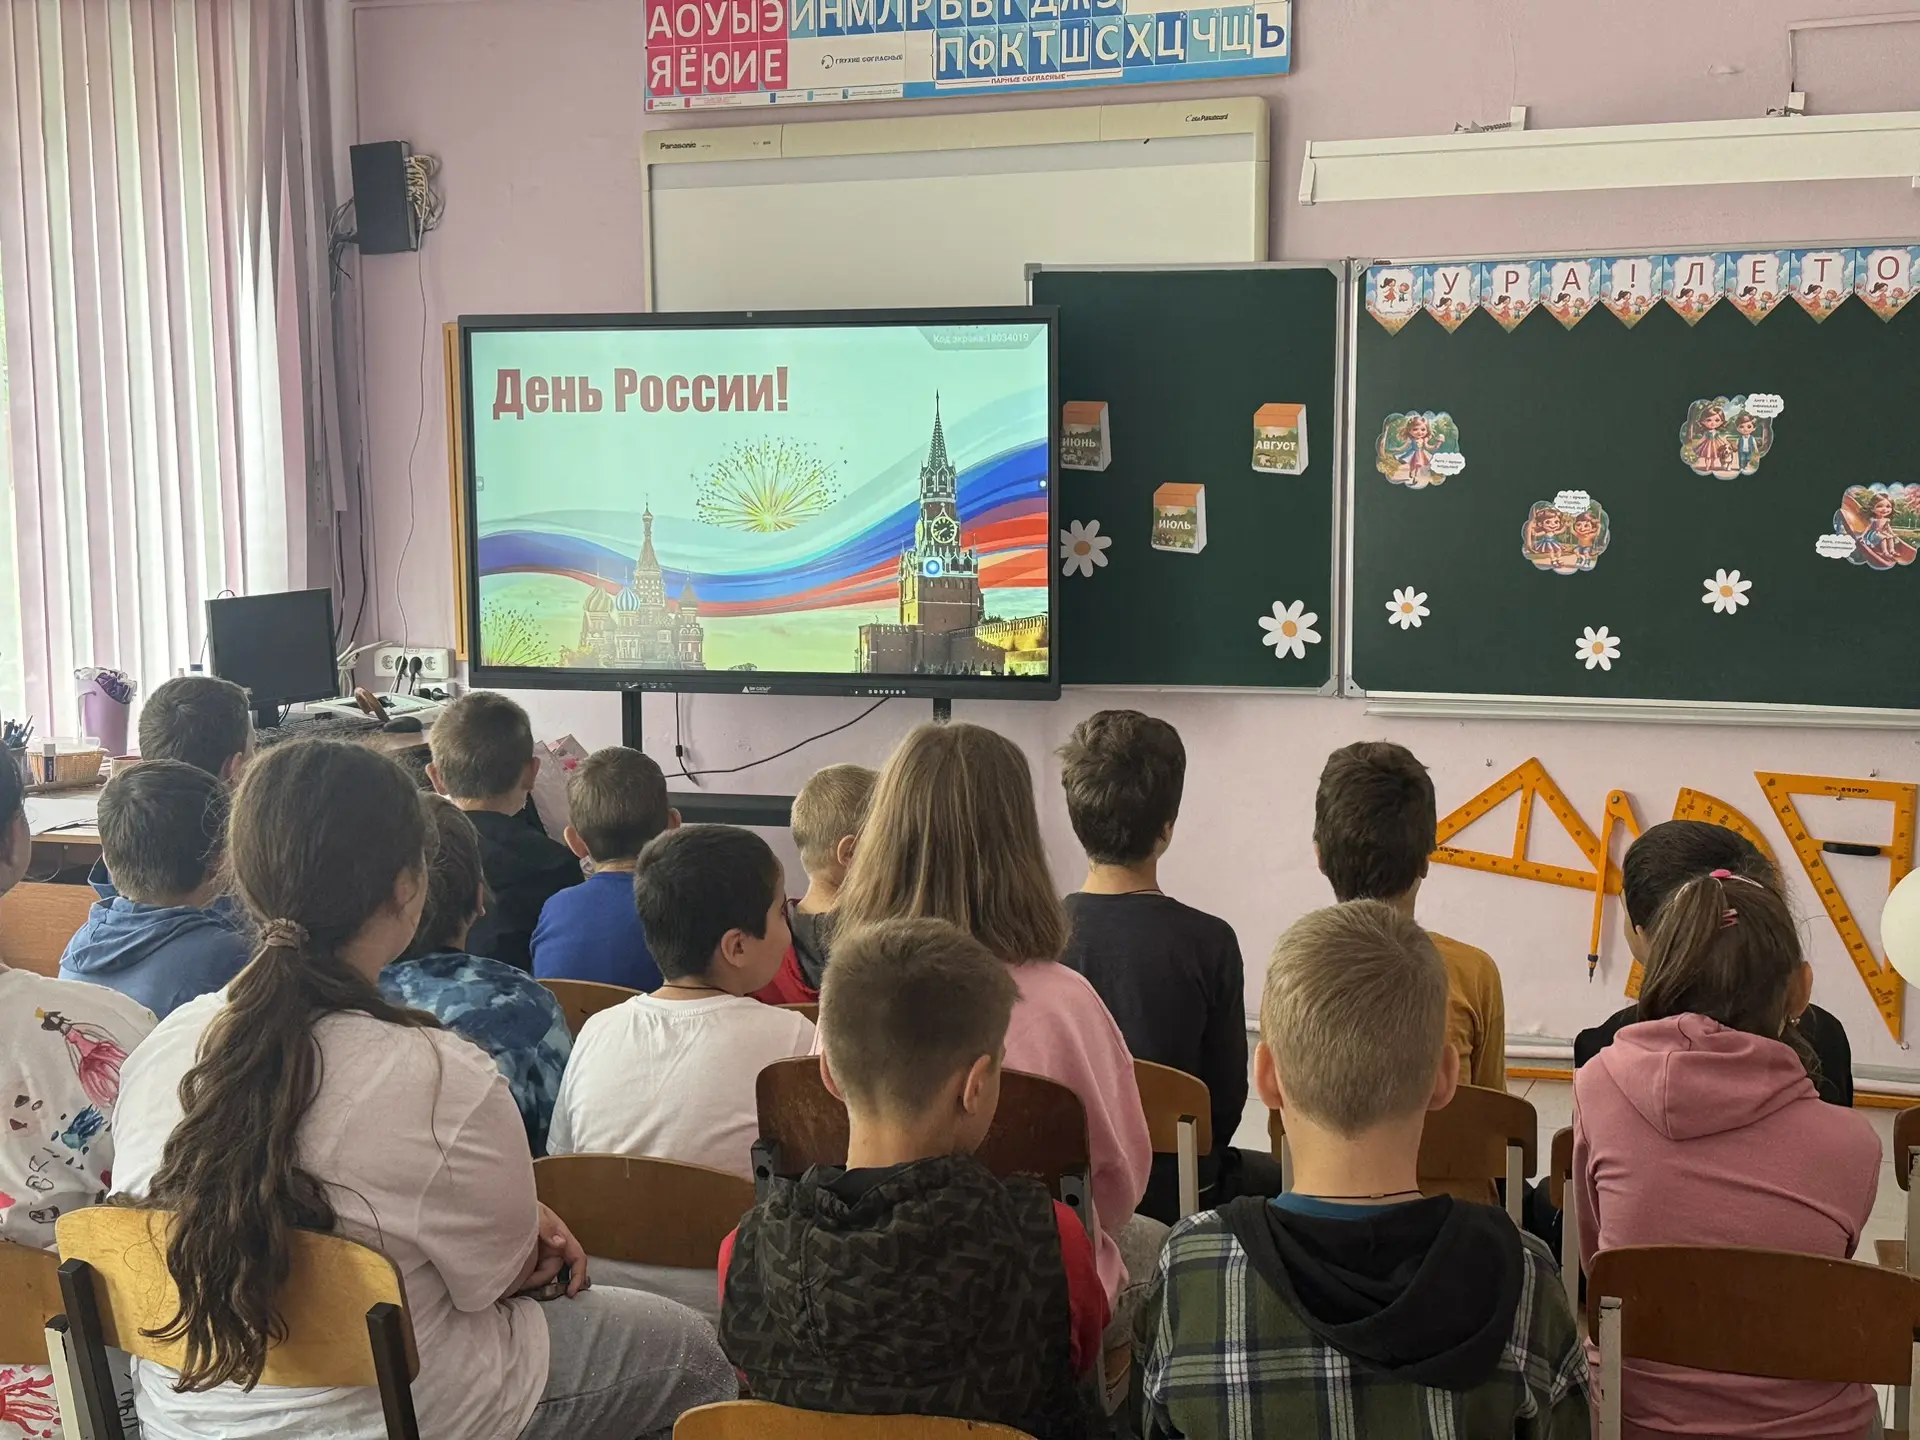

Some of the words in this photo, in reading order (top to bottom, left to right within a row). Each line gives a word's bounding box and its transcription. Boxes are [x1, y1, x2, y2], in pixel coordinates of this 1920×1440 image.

[660, 142, 697, 150] Panasonic
[493, 368, 603, 420] День
[614, 366, 788, 413] России!
[1061, 436, 1097, 448] ИЮНЬ
[1255, 439, 1297, 451] АВГУСТ
[1158, 519, 1192, 531] ИЮЛЬ
